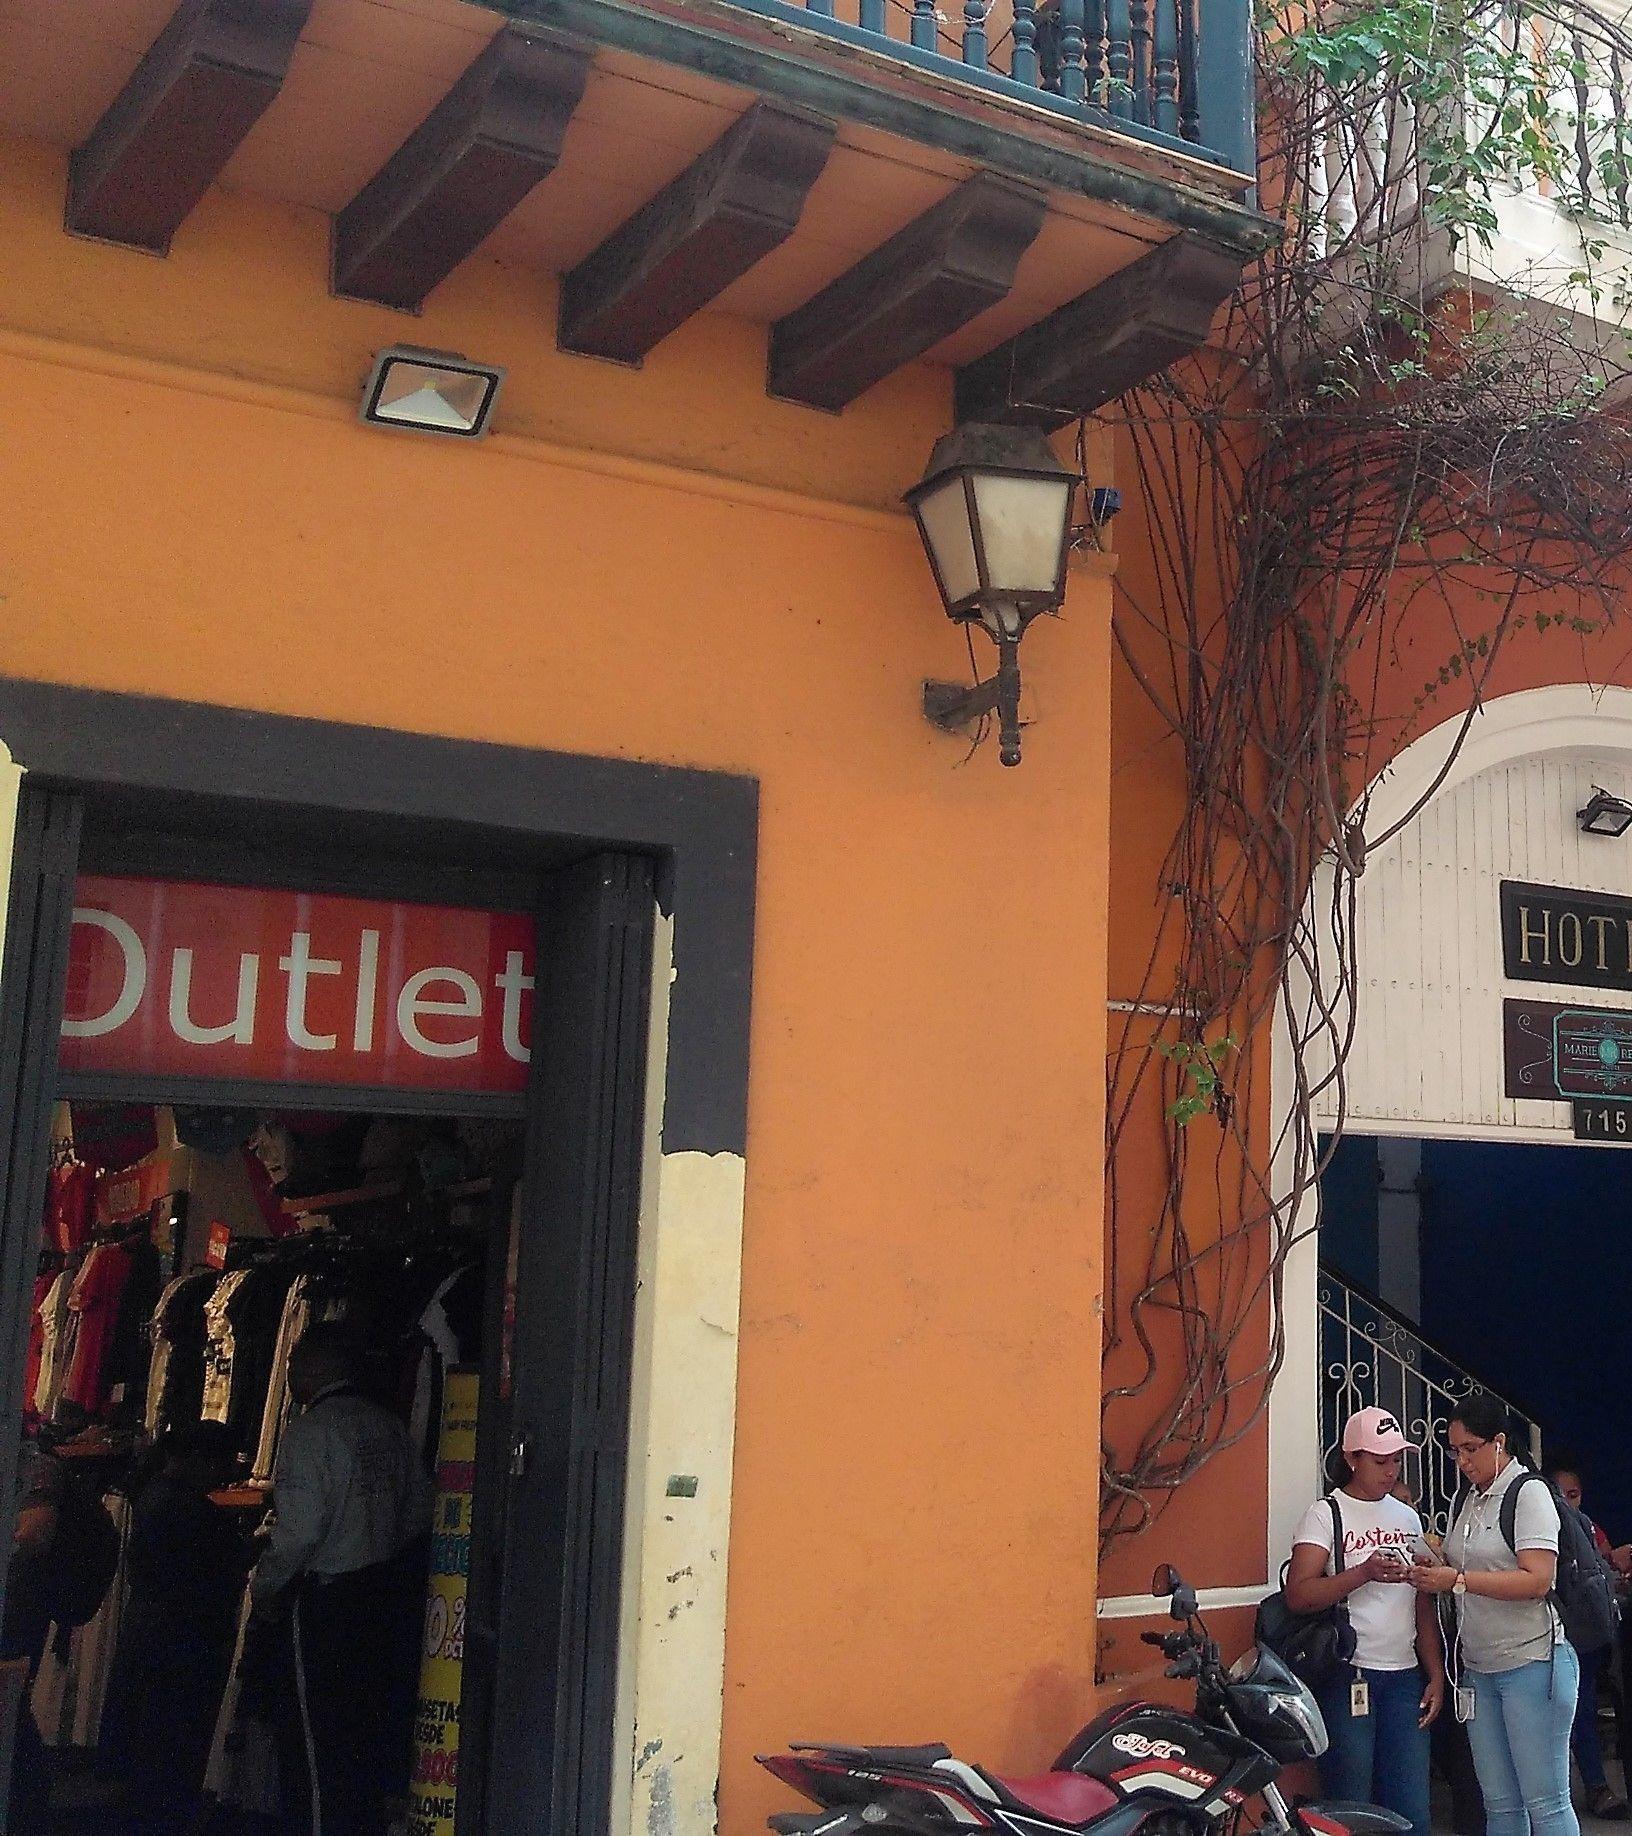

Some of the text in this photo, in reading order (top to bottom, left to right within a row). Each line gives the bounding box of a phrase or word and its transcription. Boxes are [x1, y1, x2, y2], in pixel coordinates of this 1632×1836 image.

[61, 907, 536, 1063] Outlet
[1563, 1043, 1598, 1056] MARIE
[1342, 1526, 1407, 1553] Costeñ
[1178, 1766, 1213, 1783] EVO
